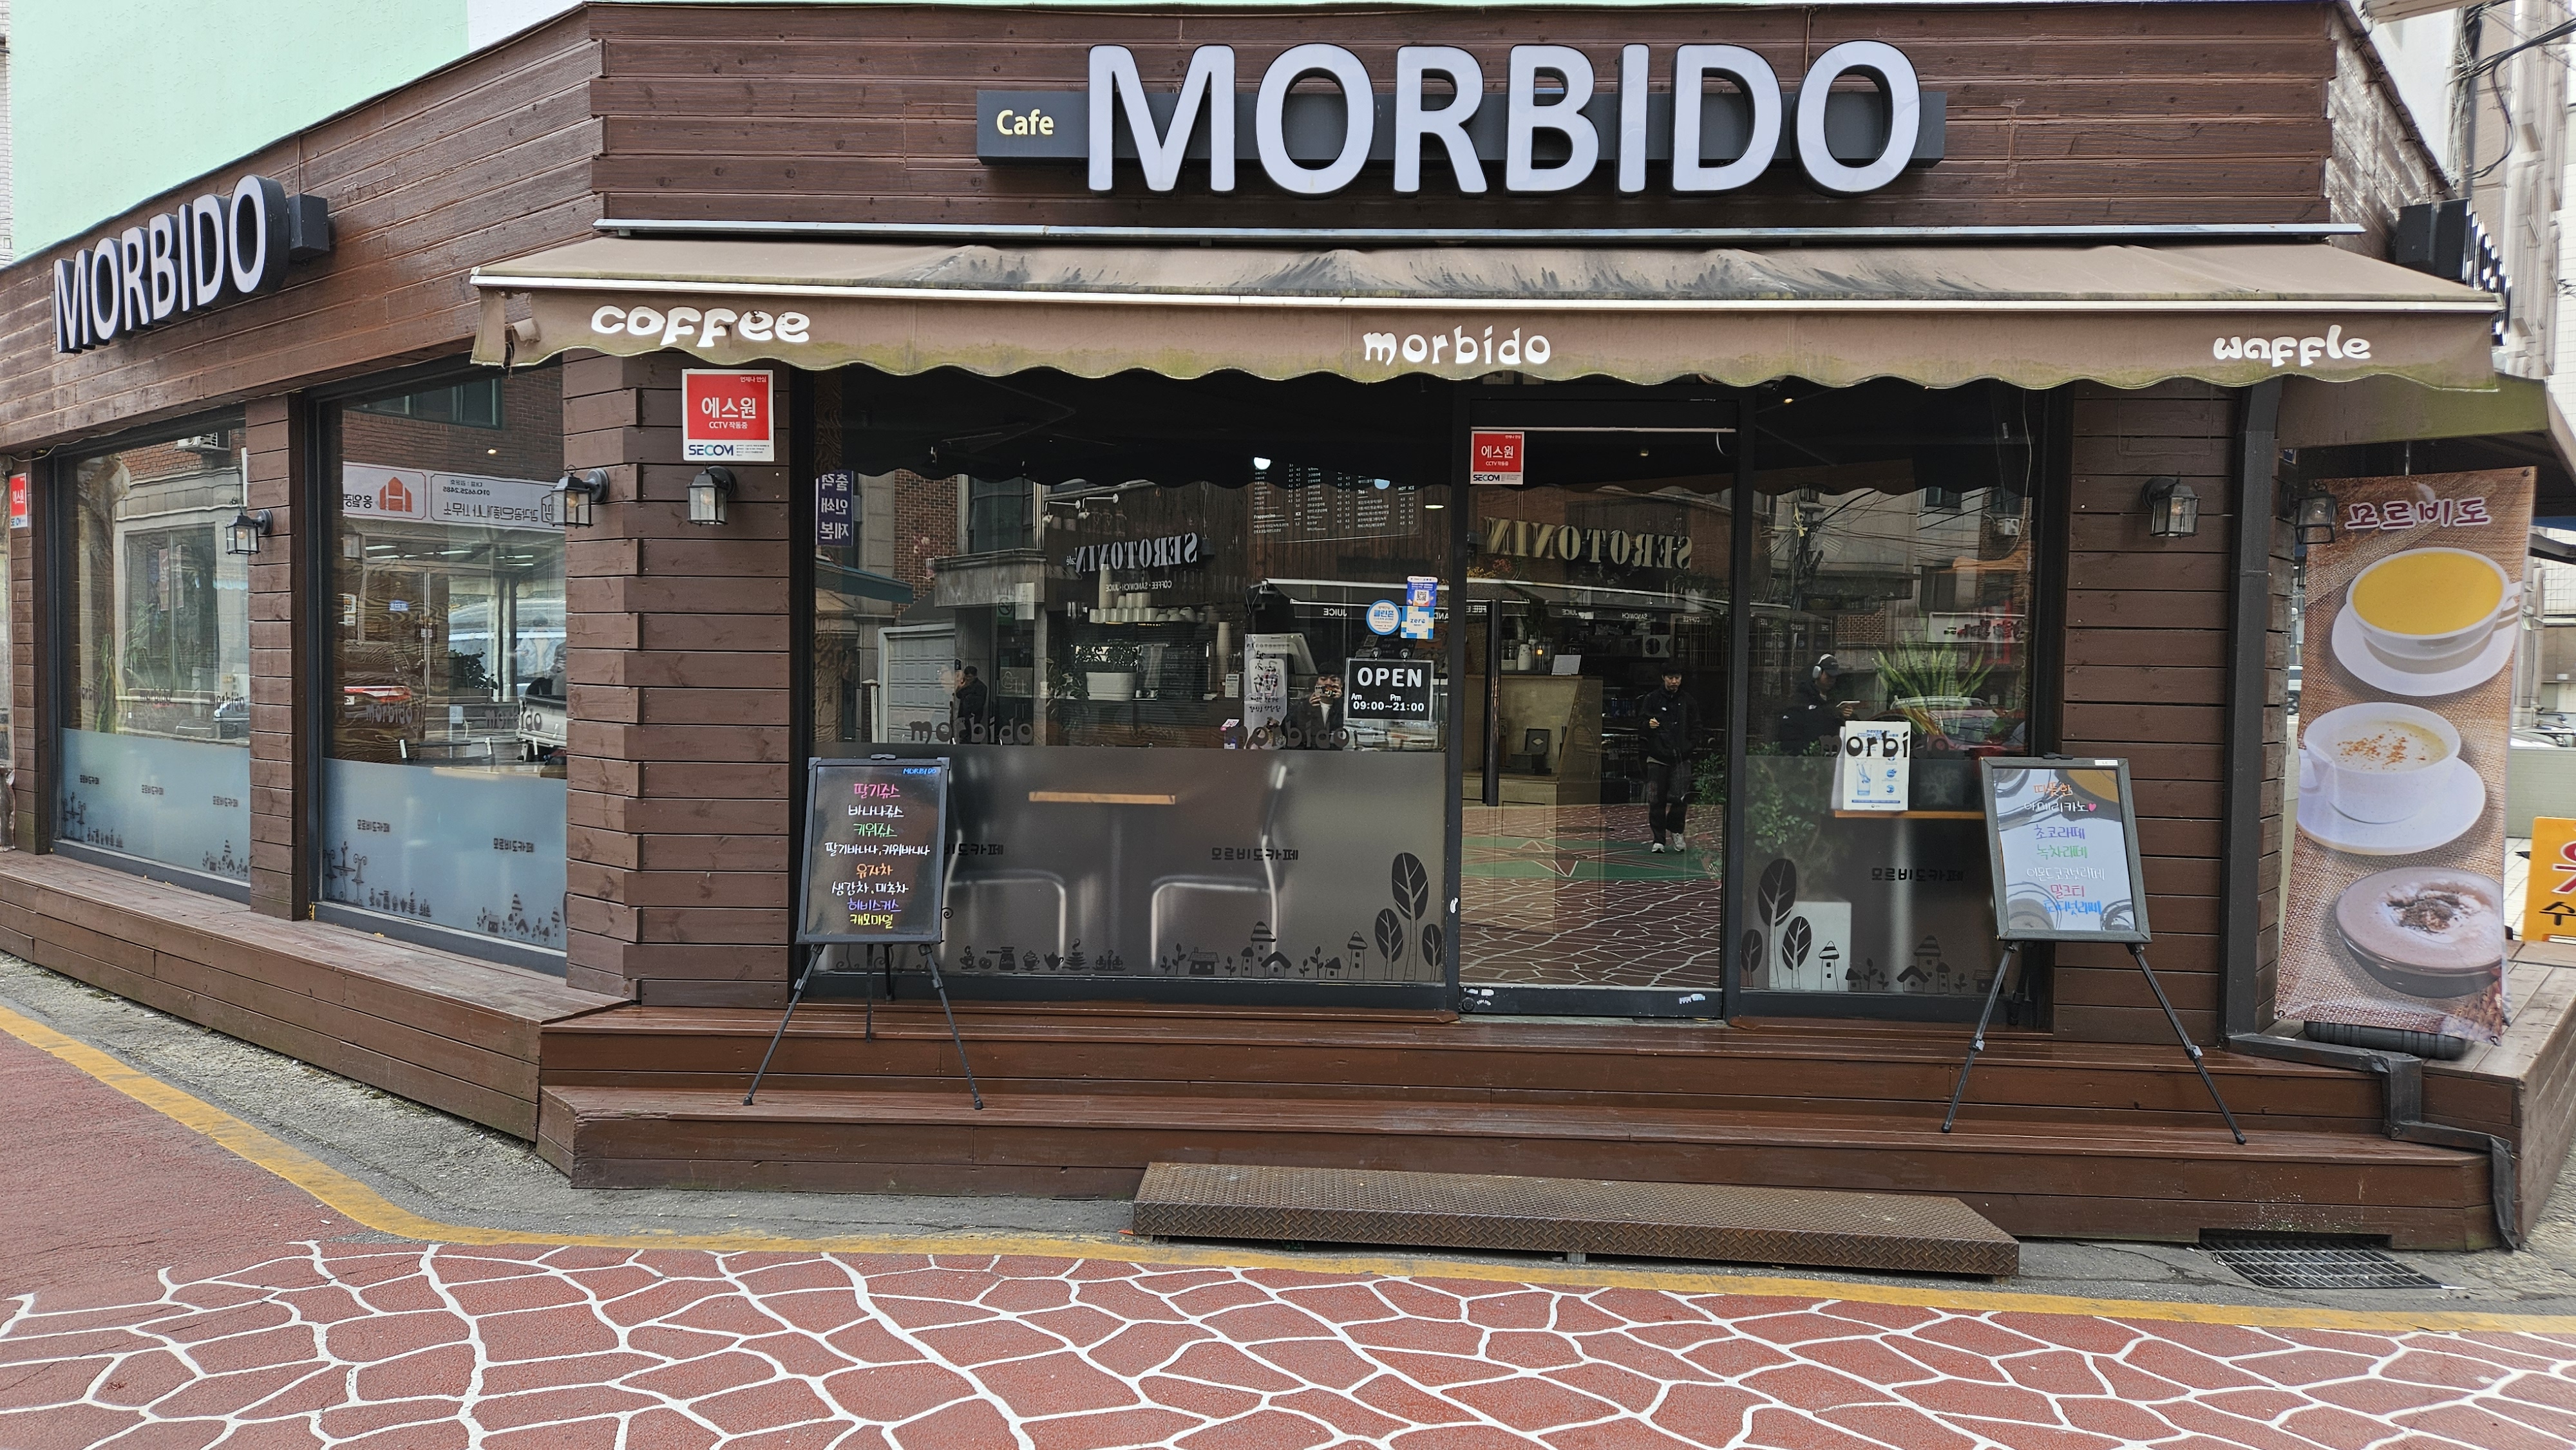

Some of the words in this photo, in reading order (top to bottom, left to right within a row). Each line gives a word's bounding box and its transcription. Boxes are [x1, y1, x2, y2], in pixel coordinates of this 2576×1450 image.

[996, 108, 1055, 137] Cafe
[1087, 40, 1921, 197] MORBIDO
[53, 174, 268, 353] MORBIDO
[591, 305, 810, 347] coffee
[1363, 325, 1551, 365] morbido
[2213, 325, 2371, 367] waffle
[701, 397, 757, 419] 에스원
[728, 421, 748, 429] 작동중
[688, 444, 734, 456] SECOM
[1481, 445, 1513, 458] 에스원
[2346, 498, 2490, 528] 모르비도
[1358, 667, 1422, 687] OPEN
[366, 702, 413, 724] morbido
[1353, 701, 1425, 711] 09:00~21:00
[909, 713, 1034, 744] morbido
[848, 804, 904, 818] 바나나쥬스
[2024, 800, 2089, 813] 아메리카노
[853, 823, 898, 838] 키위쥬스
[944, 843, 1003, 856] 비도카페
[1211, 846, 1300, 861] 모르비도카페
[856, 863, 894, 879] 유자차
[1871, 867, 1964, 882] 모르비도카페
[2050, 884, 2085, 899] 밀크티
[847, 897, 902, 912] 히비스커스
[849, 913, 894, 929] 캐모마일
